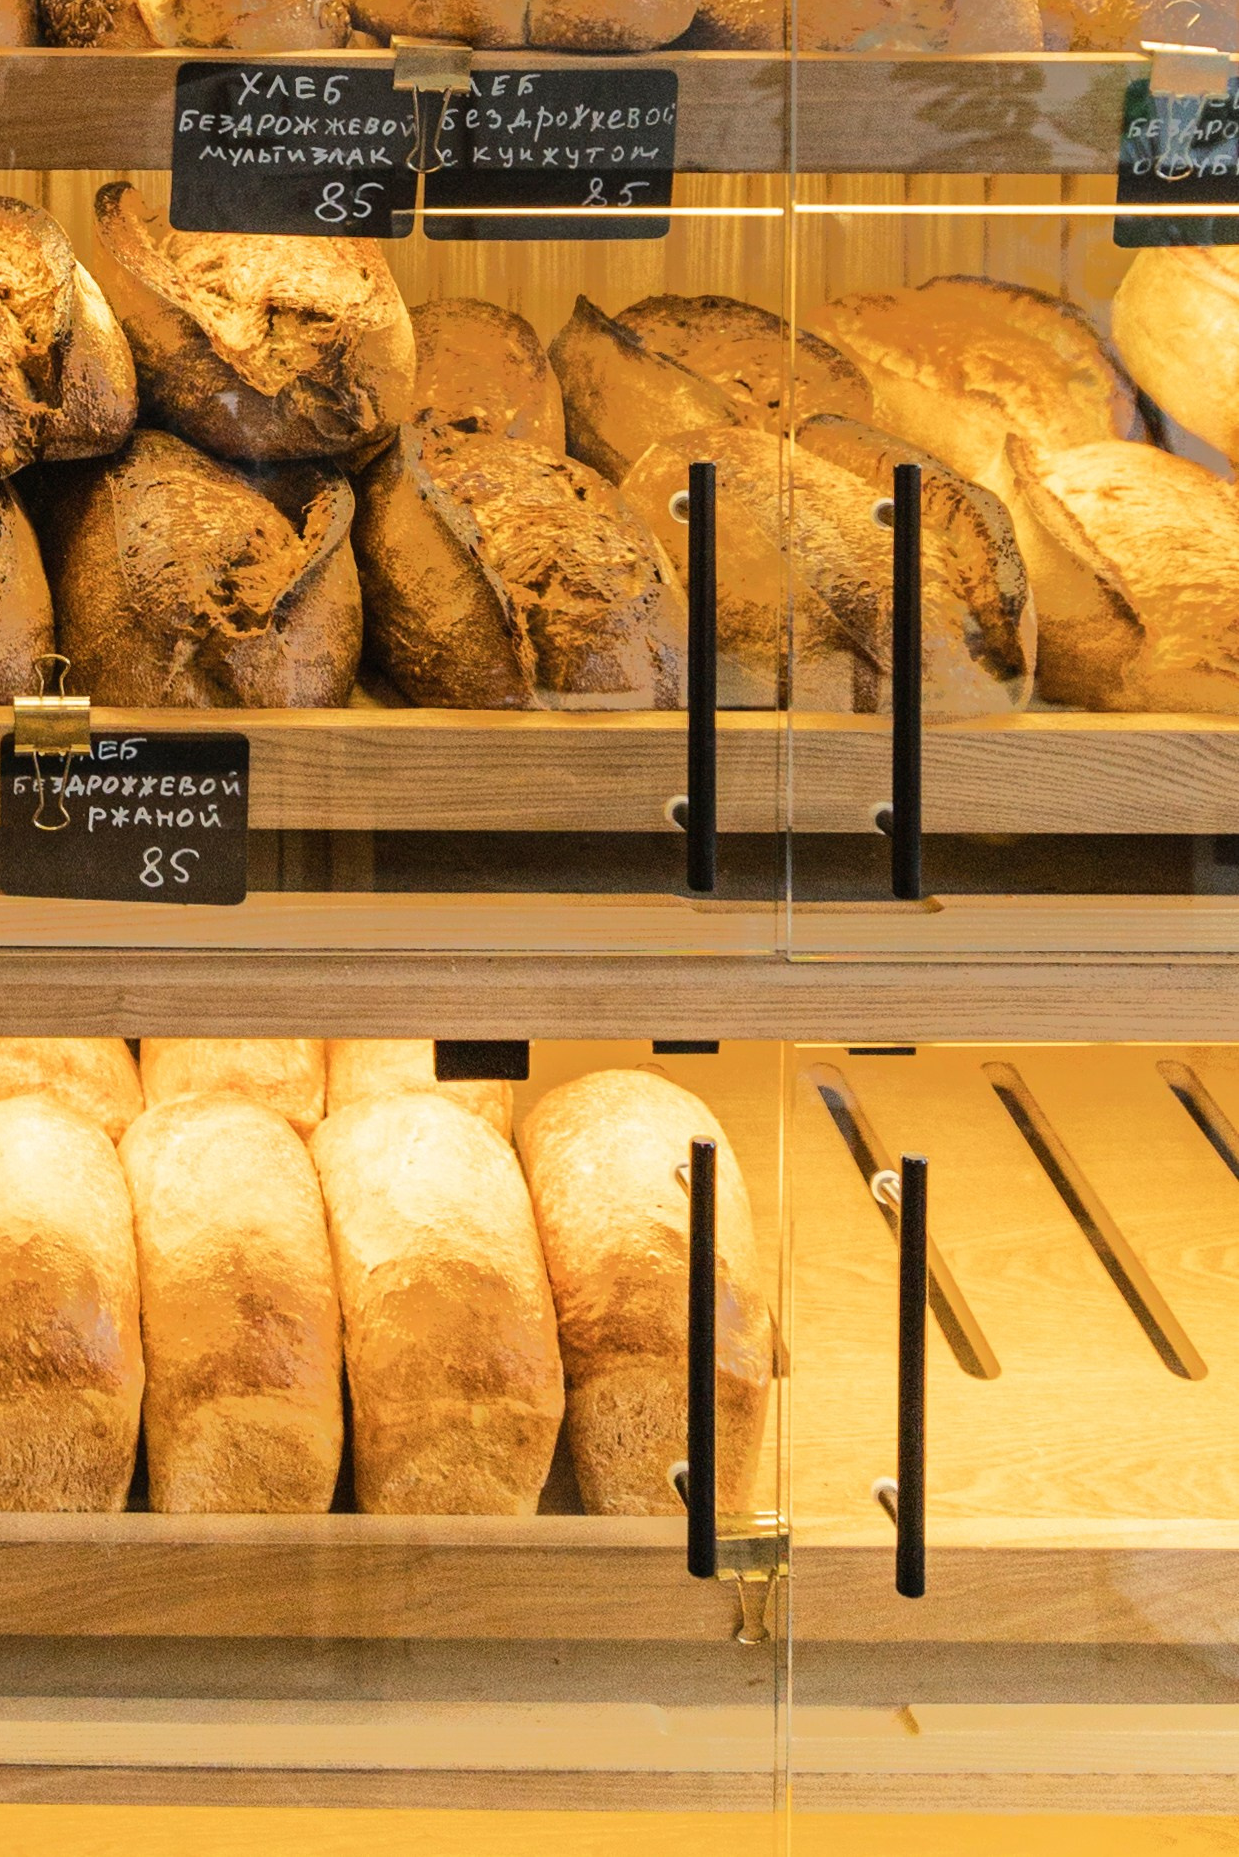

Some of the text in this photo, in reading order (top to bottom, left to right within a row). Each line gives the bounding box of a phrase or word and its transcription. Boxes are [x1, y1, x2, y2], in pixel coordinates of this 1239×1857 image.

[238, 72, 349, 105] ХЛЕБ
[465, 74, 541, 97] ЛЕБ
[179, 108, 418, 138] БЕЗДРОЖЖЕВОЙ
[199, 145, 393, 167] МУЛЬТИЗЛАК
[314, 182, 385, 223] 85
[582, 177, 651, 207] 85
[13, 771, 242, 798] БЕЗДРОЖЖЕВОЙ
[87, 804, 223, 832] РЖАНОЙ
[139, 846, 200, 888] 85
